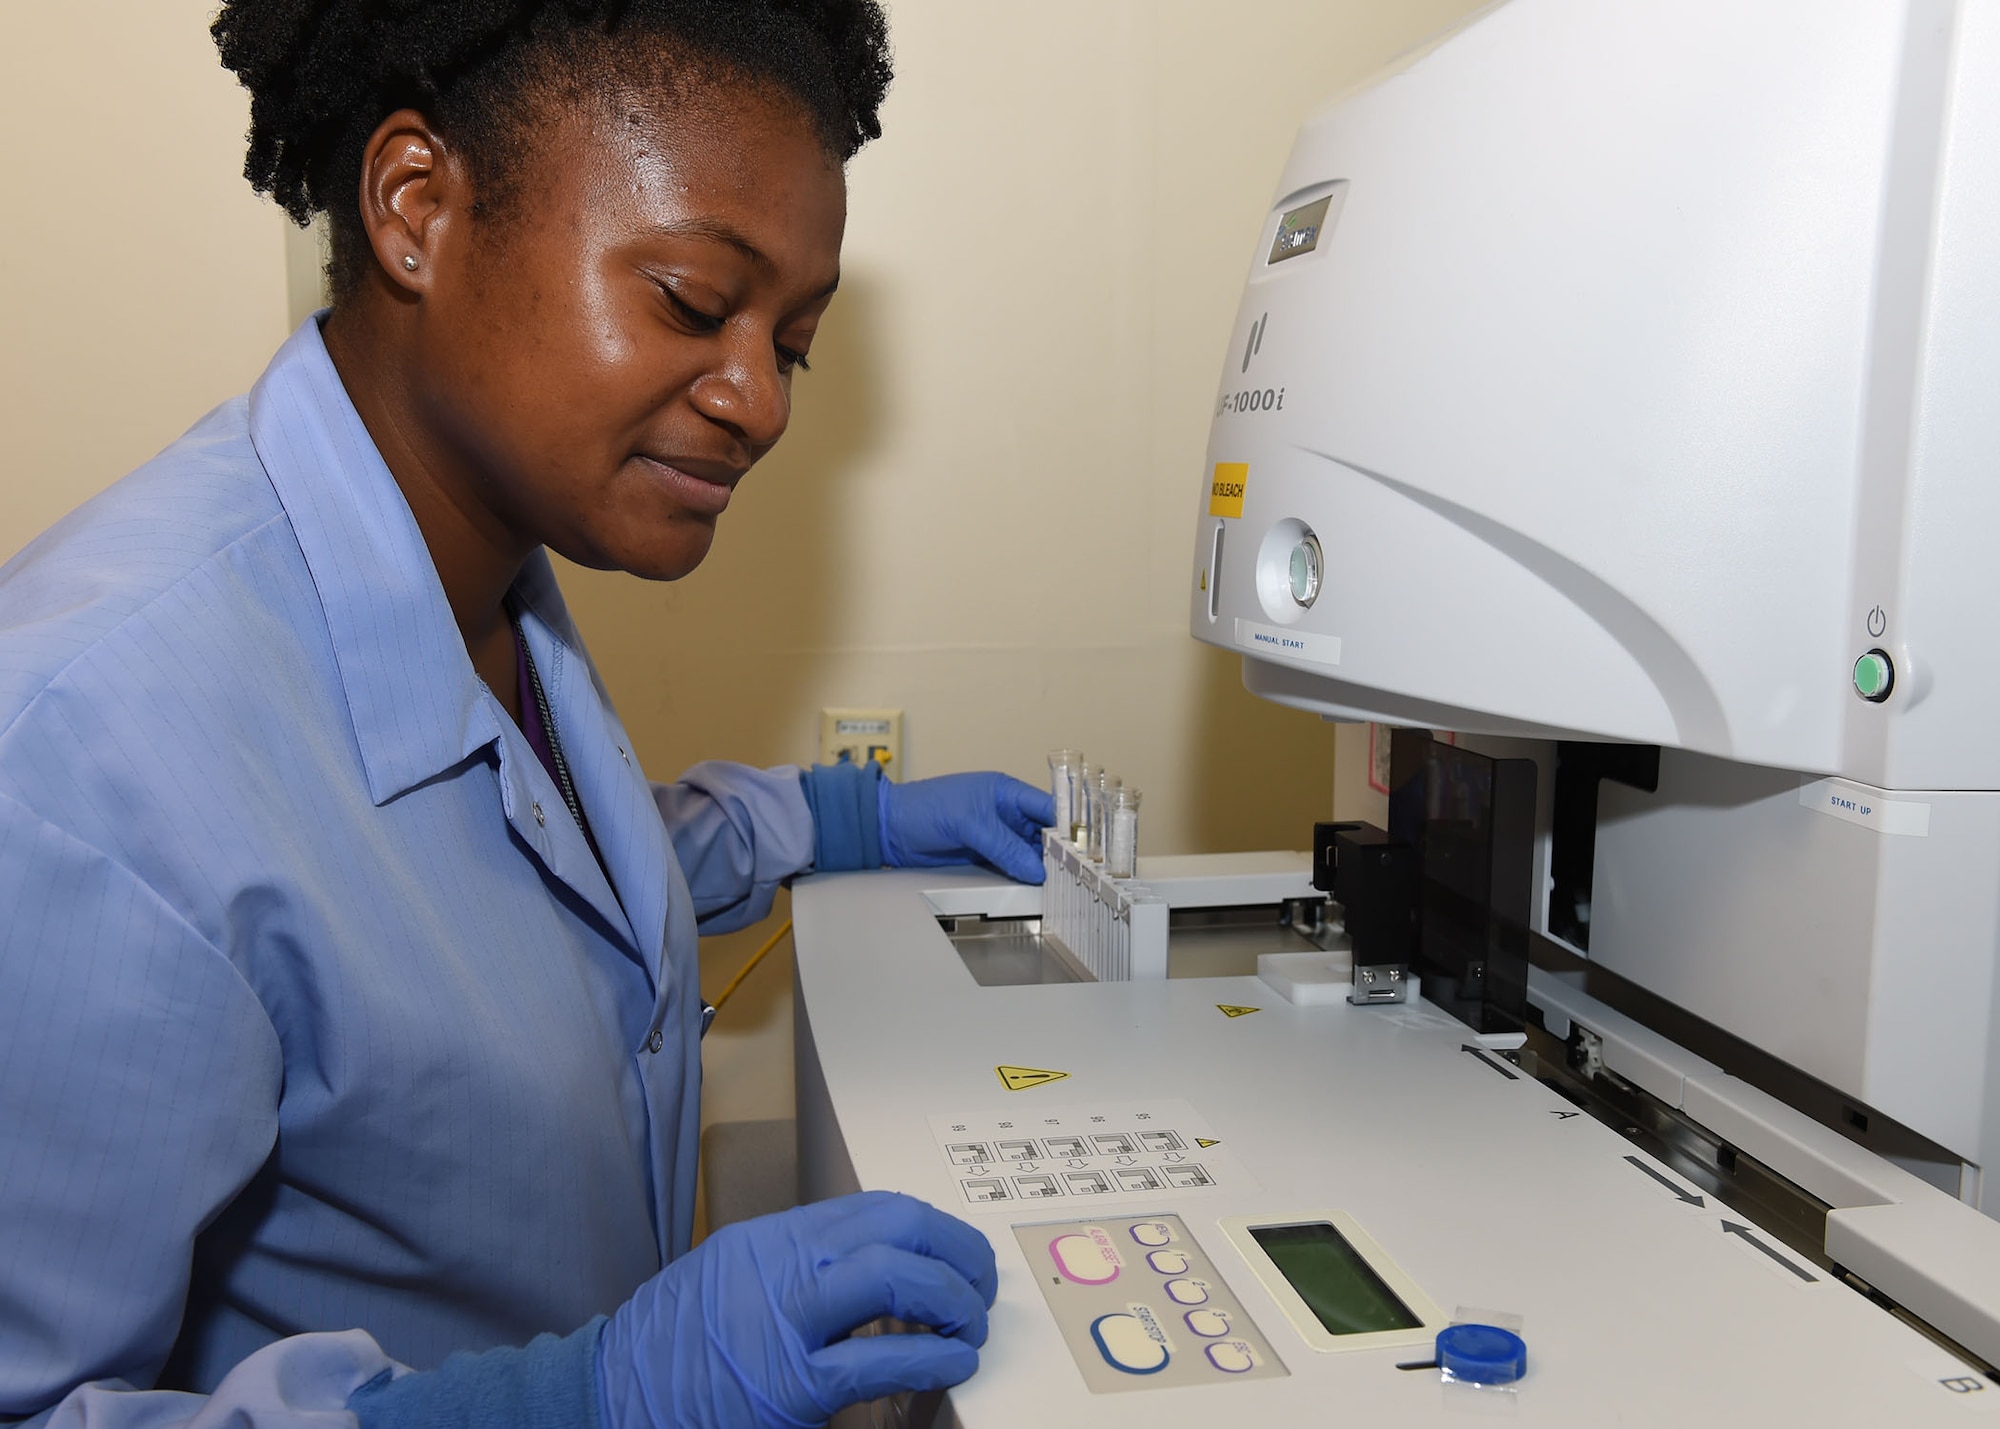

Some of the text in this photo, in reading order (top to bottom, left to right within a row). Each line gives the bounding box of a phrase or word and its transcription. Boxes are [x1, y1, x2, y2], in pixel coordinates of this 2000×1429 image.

[1219, 482, 1244, 498] BLEACH
[1254, 633, 1304, 649] MANUAL START
[1830, 796, 1872, 815] START UP
[1549, 1110, 1580, 1120] A
[1090, 1229, 1121, 1265] ALARM RESET
[1937, 1376, 1984, 1393] B
